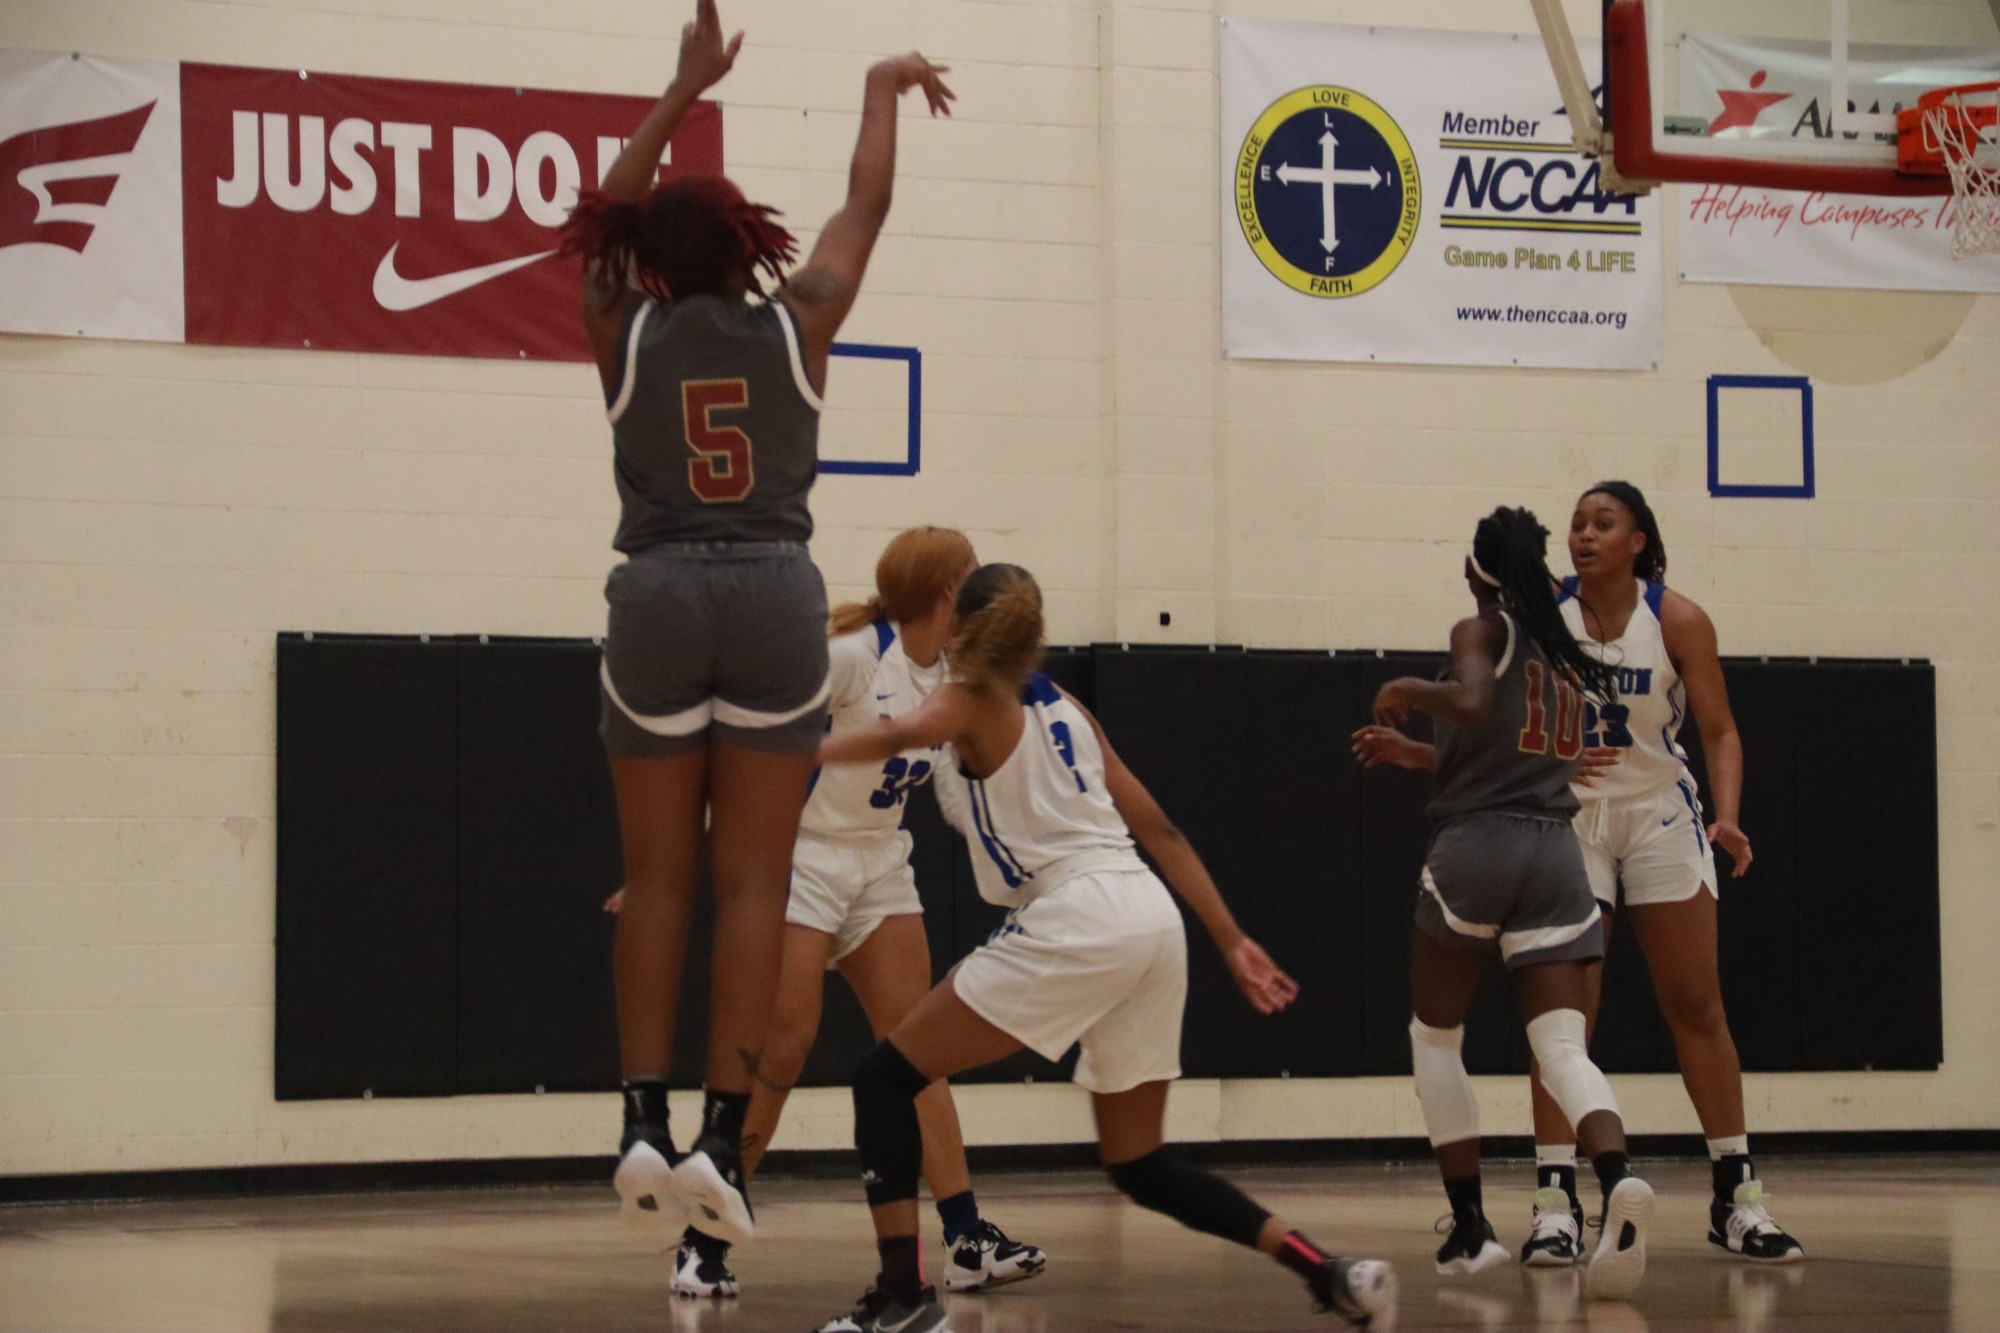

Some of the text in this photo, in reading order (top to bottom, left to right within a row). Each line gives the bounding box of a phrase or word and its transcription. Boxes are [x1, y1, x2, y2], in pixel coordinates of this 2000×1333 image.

[1312, 90, 1351, 107] LOVE
[1324, 112, 1334, 128] L
[1442, 112, 1541, 137] Member
[216, 110, 432, 218] JUST
[452, 126, 581, 228] DO
[1240, 134, 1263, 244] EXCELLENCE
[1400, 157, 1419, 247] INTEGRITY
[1690, 184, 1794, 237] Helping
[1800, 192, 1930, 241] Campuses
[1444, 245, 1636, 273] Game Plan 4 LIFE
[1310, 277, 1353, 294] FAITH
[1456, 305, 1628, 330] www.thenccaa.org
[681, 378, 755, 504] 5
[1518, 658, 1584, 761] 10
